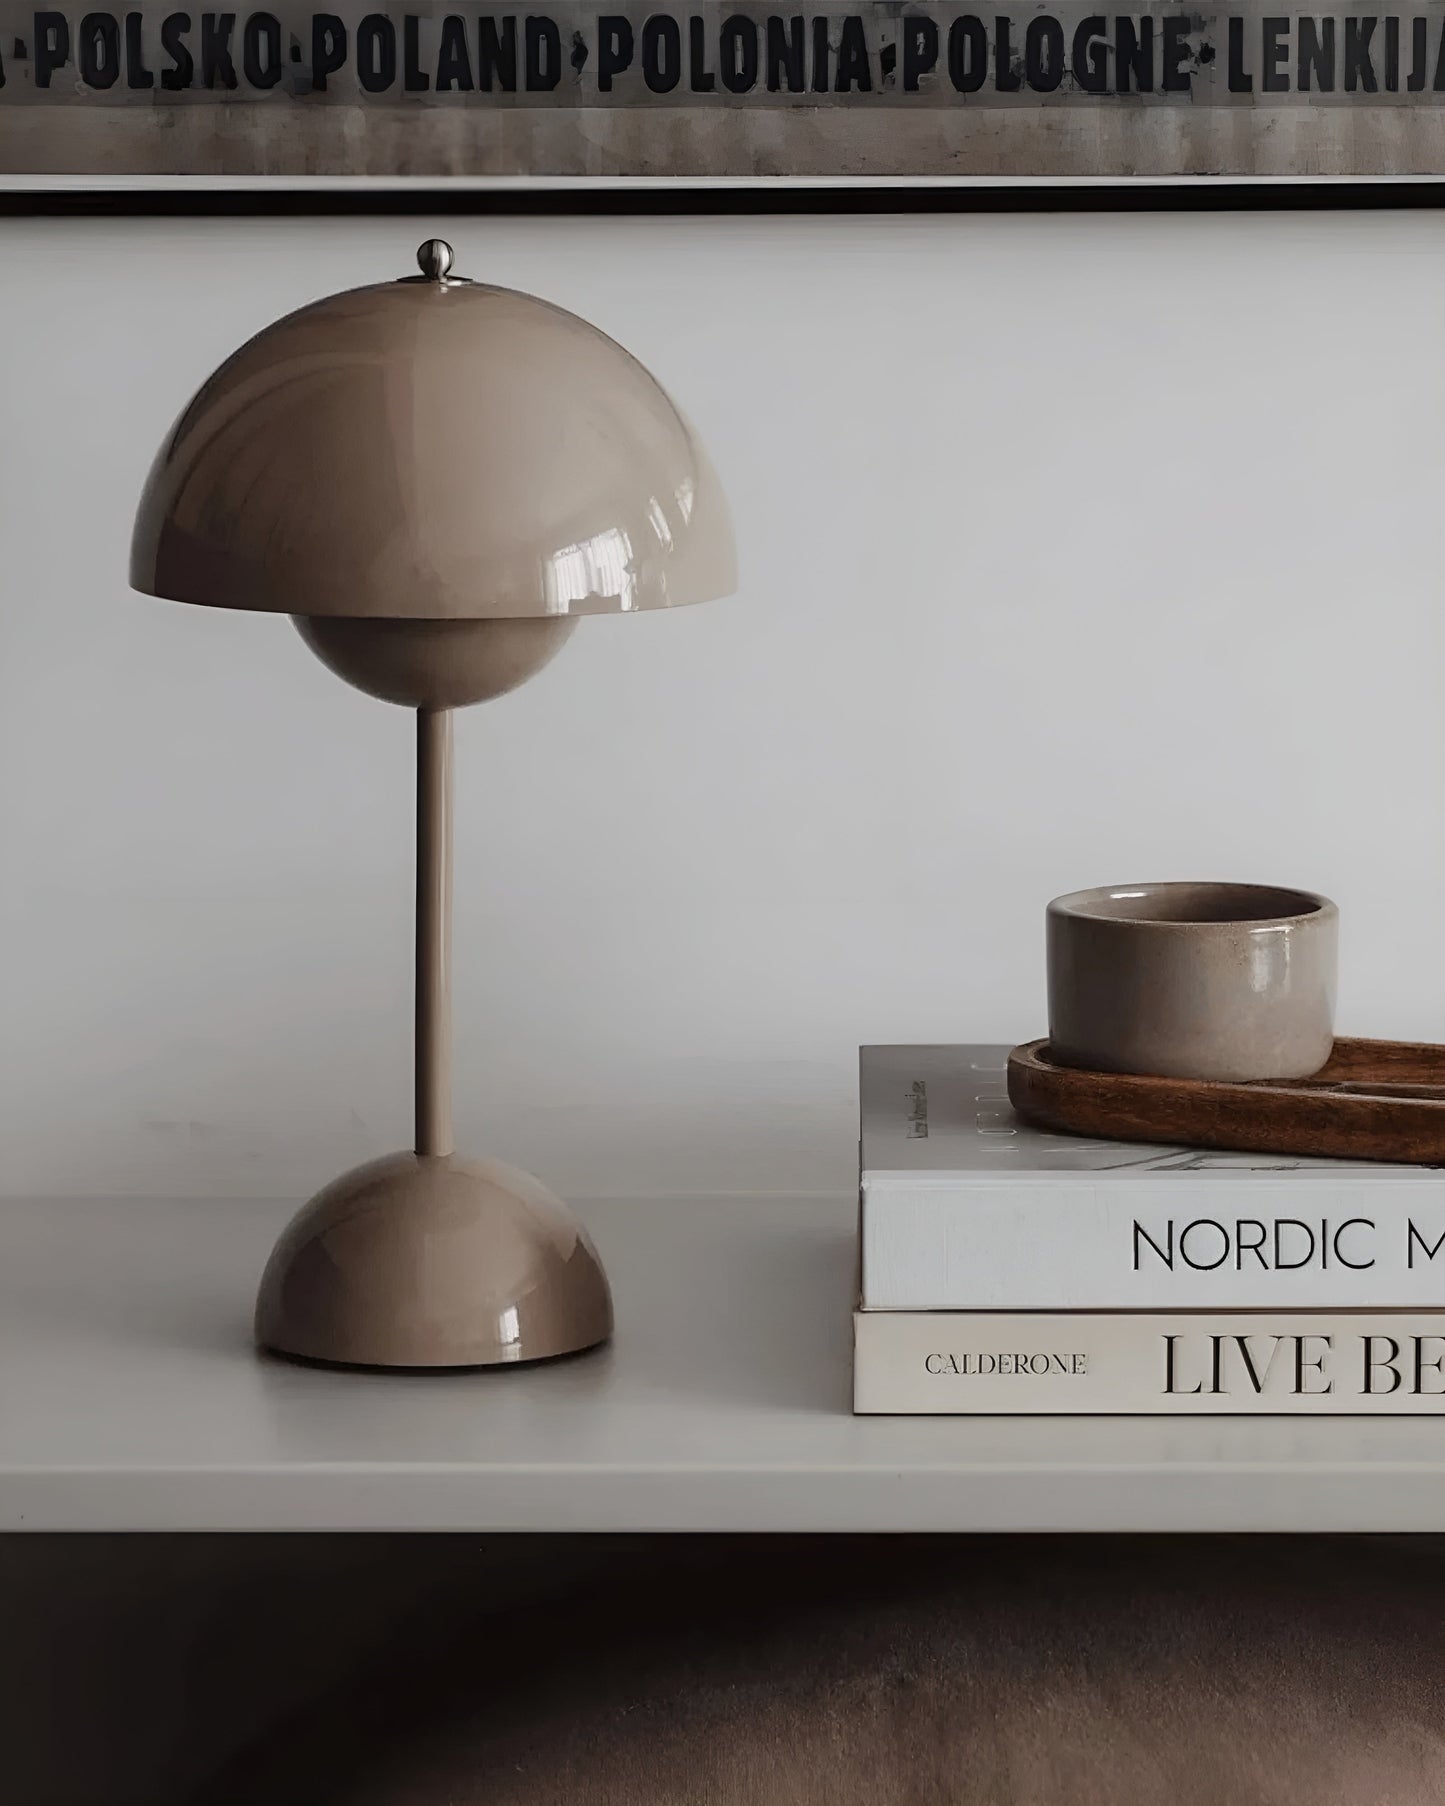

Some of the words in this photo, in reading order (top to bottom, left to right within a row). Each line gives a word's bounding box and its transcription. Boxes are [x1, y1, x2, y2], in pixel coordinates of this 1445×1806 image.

[34, 11, 282, 90] POLSKO
[312, 13, 560, 92] POLAND
[598, 14, 872, 93] POLONIA
[903, 14, 1192, 92] POLOGNE
[1133, 1218, 1376, 1271] NORDIC
[1407, 1218, 1445, 1270] M
[925, 1353, 1087, 1376] CALDERONE
[1160, 1335, 1332, 1395] LIVE
[1358, 1335, 1445, 1395] BE
